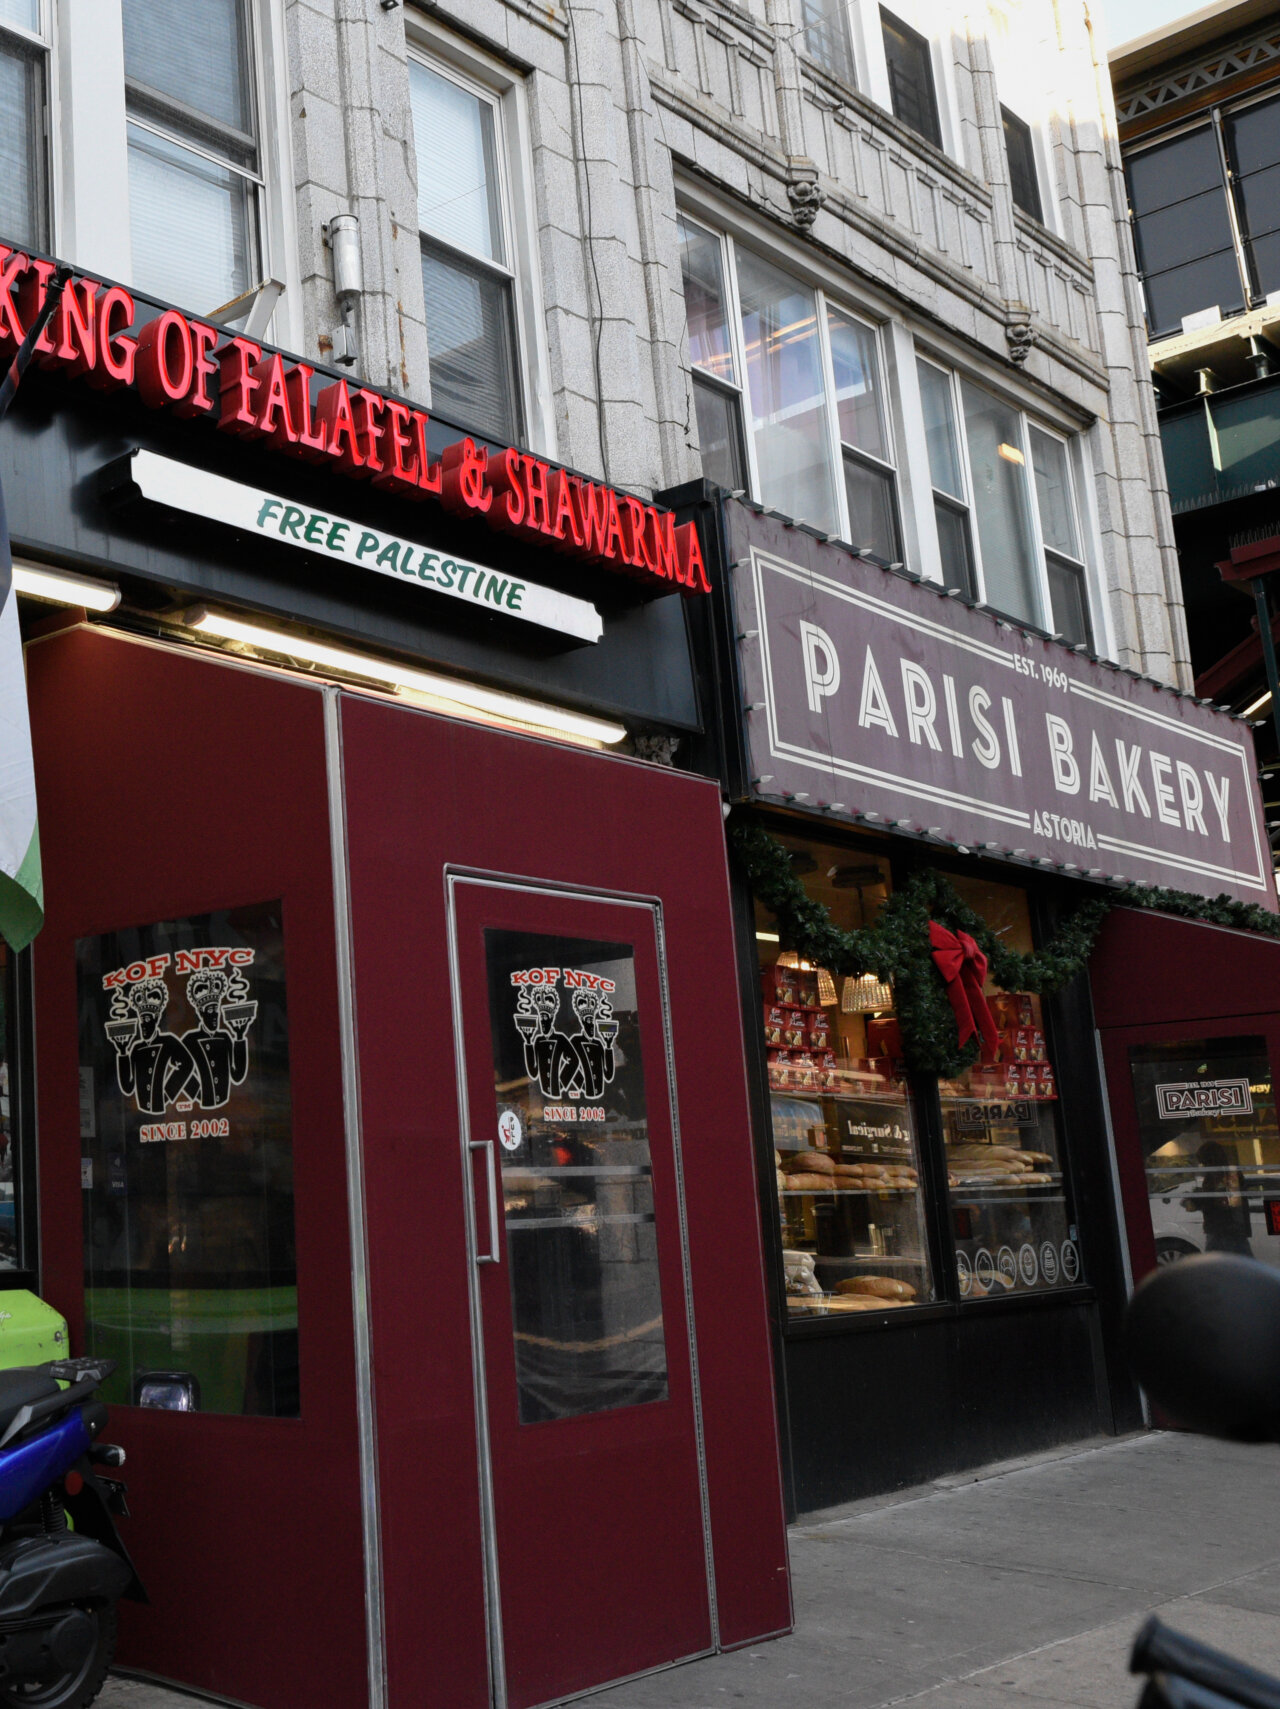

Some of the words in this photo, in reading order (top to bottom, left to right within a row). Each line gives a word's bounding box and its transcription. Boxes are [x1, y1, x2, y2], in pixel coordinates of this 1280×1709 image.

[156, 308, 219, 412] OF
[232, 335, 443, 495] FALAFEL
[459, 437, 493, 513] &
[505, 446, 713, 594] SHAWARMA
[256, 498, 351, 552] FREE
[355, 530, 526, 610] PALESTINE
[1013, 653, 1038, 679] EST.
[1040, 663, 1069, 693] 1969
[800, 619, 1023, 778] PARISI
[1045, 713, 1231, 844] BAKERY
[1033, 809, 1098, 851] ASTORIA
[102, 953, 171, 990] KOF
[175, 947, 256, 973] NYC
[510, 967, 561, 986] KOF
[563, 968, 616, 993] NYC
[544, 1106, 578, 1121] SINCE
[579, 1106, 606, 1121] 2002
[1166, 1087, 1241, 1110] PARISI
[139, 1121, 187, 1143] SINCE
[189, 1118, 230, 1138] 2002
